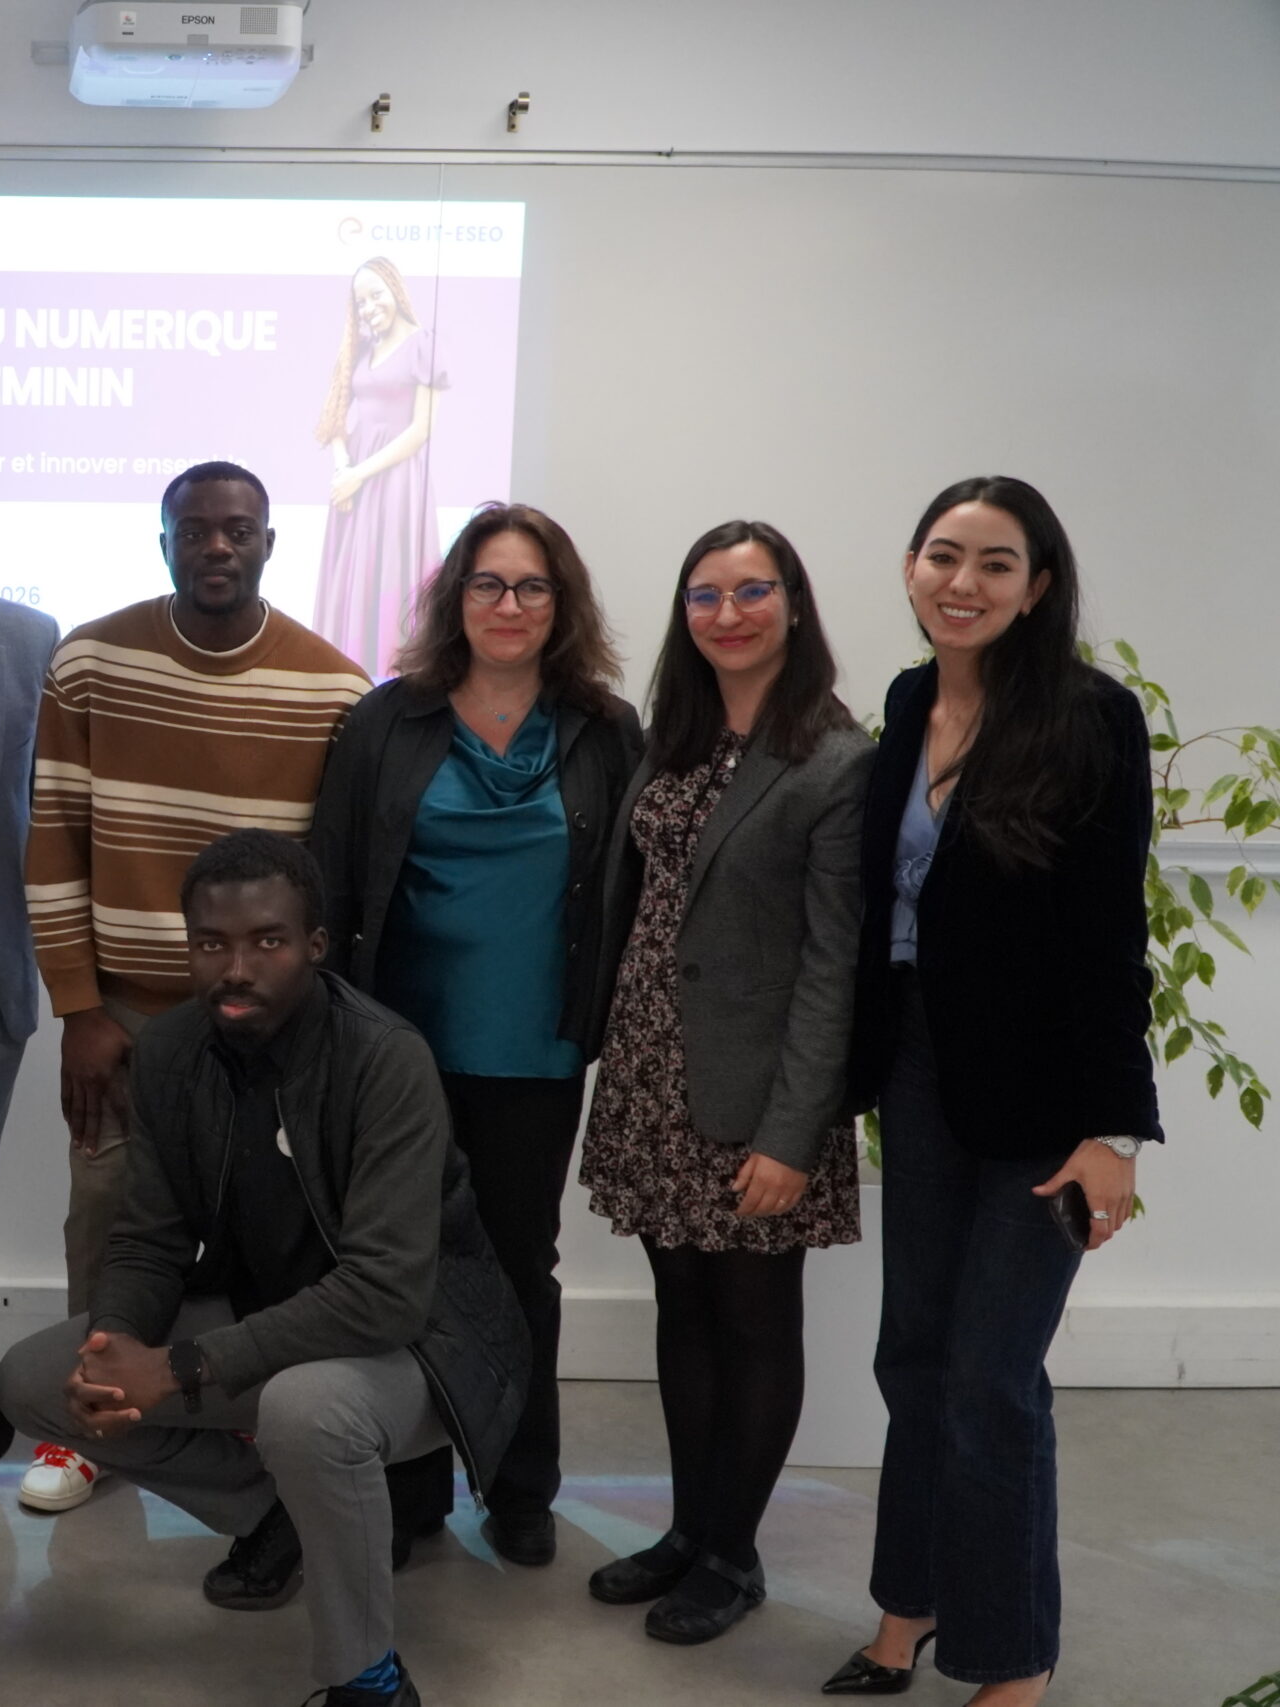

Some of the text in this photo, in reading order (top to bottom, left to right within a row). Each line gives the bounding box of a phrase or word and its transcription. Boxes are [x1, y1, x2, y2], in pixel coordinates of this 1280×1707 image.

[182, 16, 215, 25] EPSON
[371, 225, 503, 242] CLUB IT-ESEO
[16, 308, 278, 356] NUMERIQUE
[11, 453, 34, 473] et
[40, 452, 126, 474] innover
